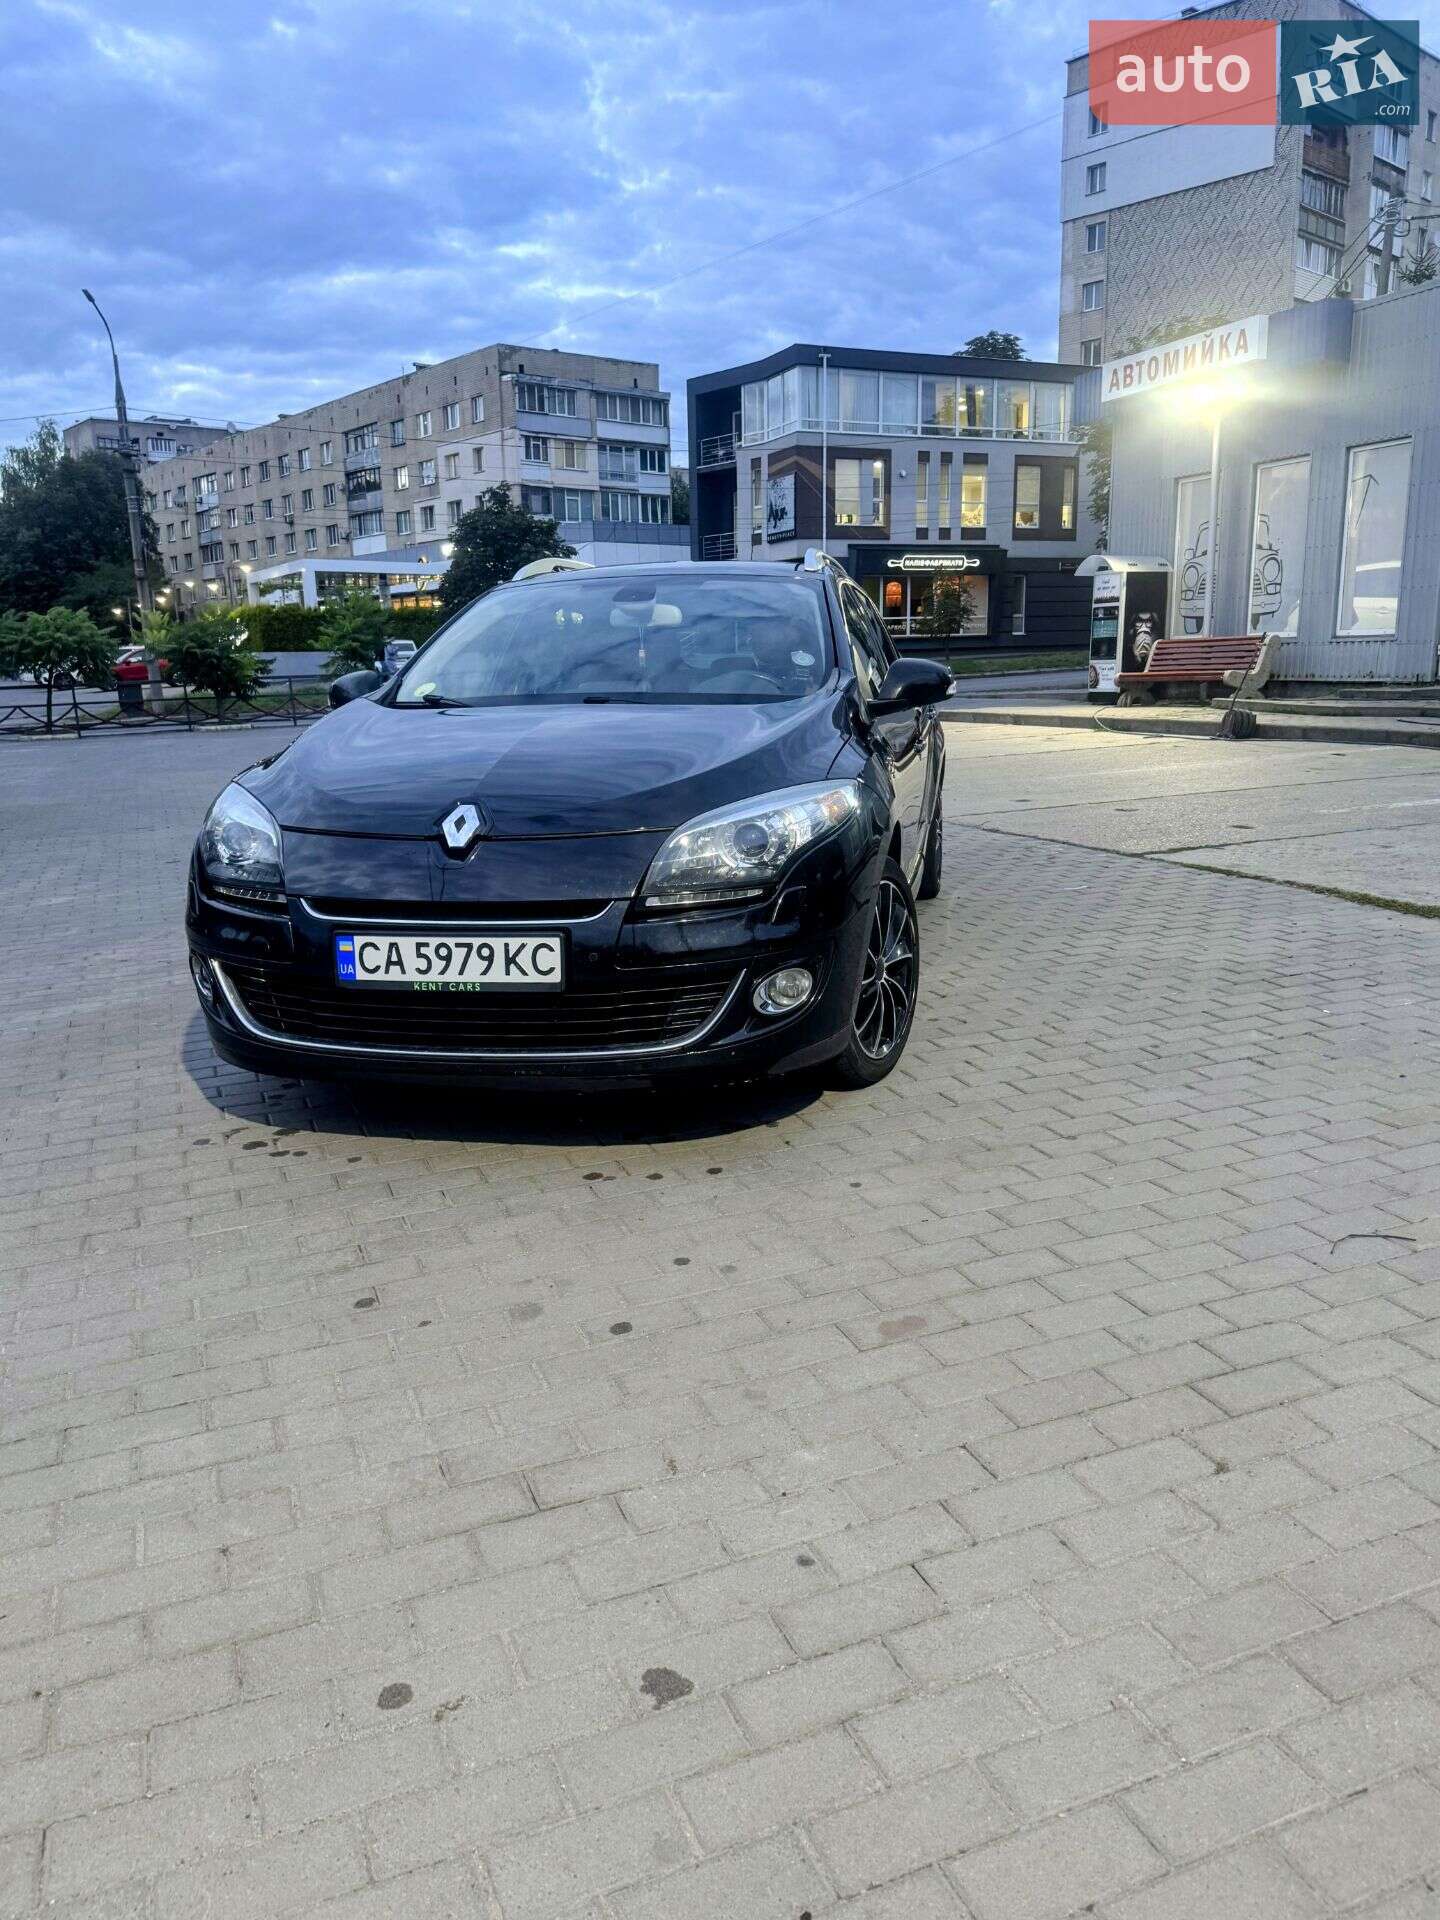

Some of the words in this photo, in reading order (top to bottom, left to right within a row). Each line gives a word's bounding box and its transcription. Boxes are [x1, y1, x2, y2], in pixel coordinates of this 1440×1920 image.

[1109, 328, 1249, 393] АВТОМИЙКА
[339, 962, 355, 975] UA
[358, 942, 406, 975] CA
[415, 942, 495, 976] 5979
[504, 942, 556, 976] KC
[413, 981, 444, 991] KENT
[449, 982, 481, 992] CARS
